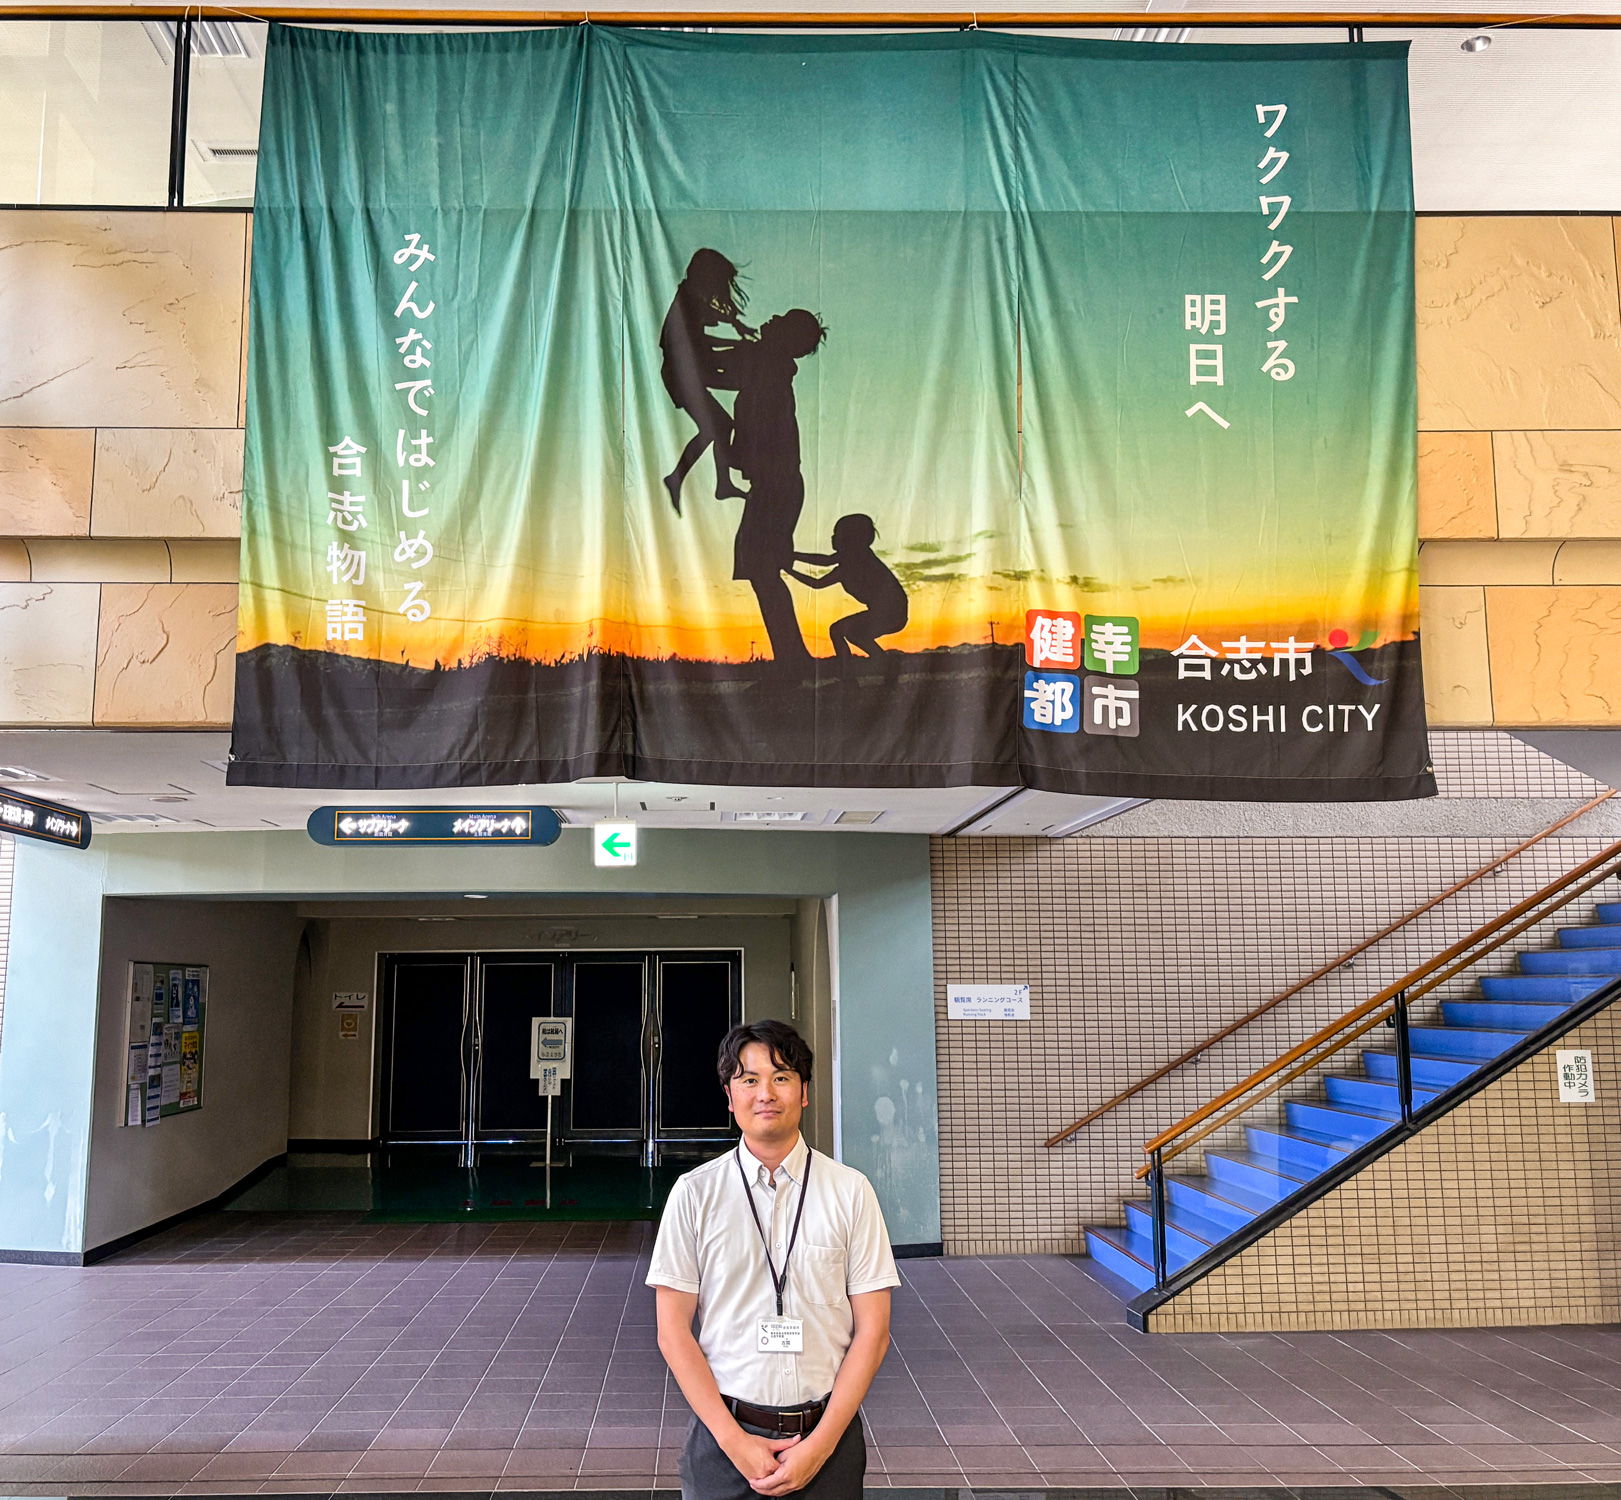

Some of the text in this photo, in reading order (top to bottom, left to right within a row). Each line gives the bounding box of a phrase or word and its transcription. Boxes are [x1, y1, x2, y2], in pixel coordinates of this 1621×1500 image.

[1255, 104, 1299, 381] ワクワクする
[1184, 294, 1230, 430] 明日へ
[393, 232, 435, 622] みんなではじめる
[325, 435, 368, 641] 合志物語
[1170, 633, 1315, 682] 合志市
[1176, 703, 1381, 733] KOSHI CITY
[334, 993, 366, 1001] トイレ
[1562, 1063, 1576, 1089] 作動中
[1574, 1055, 1589, 1098] 防犯カメラ
